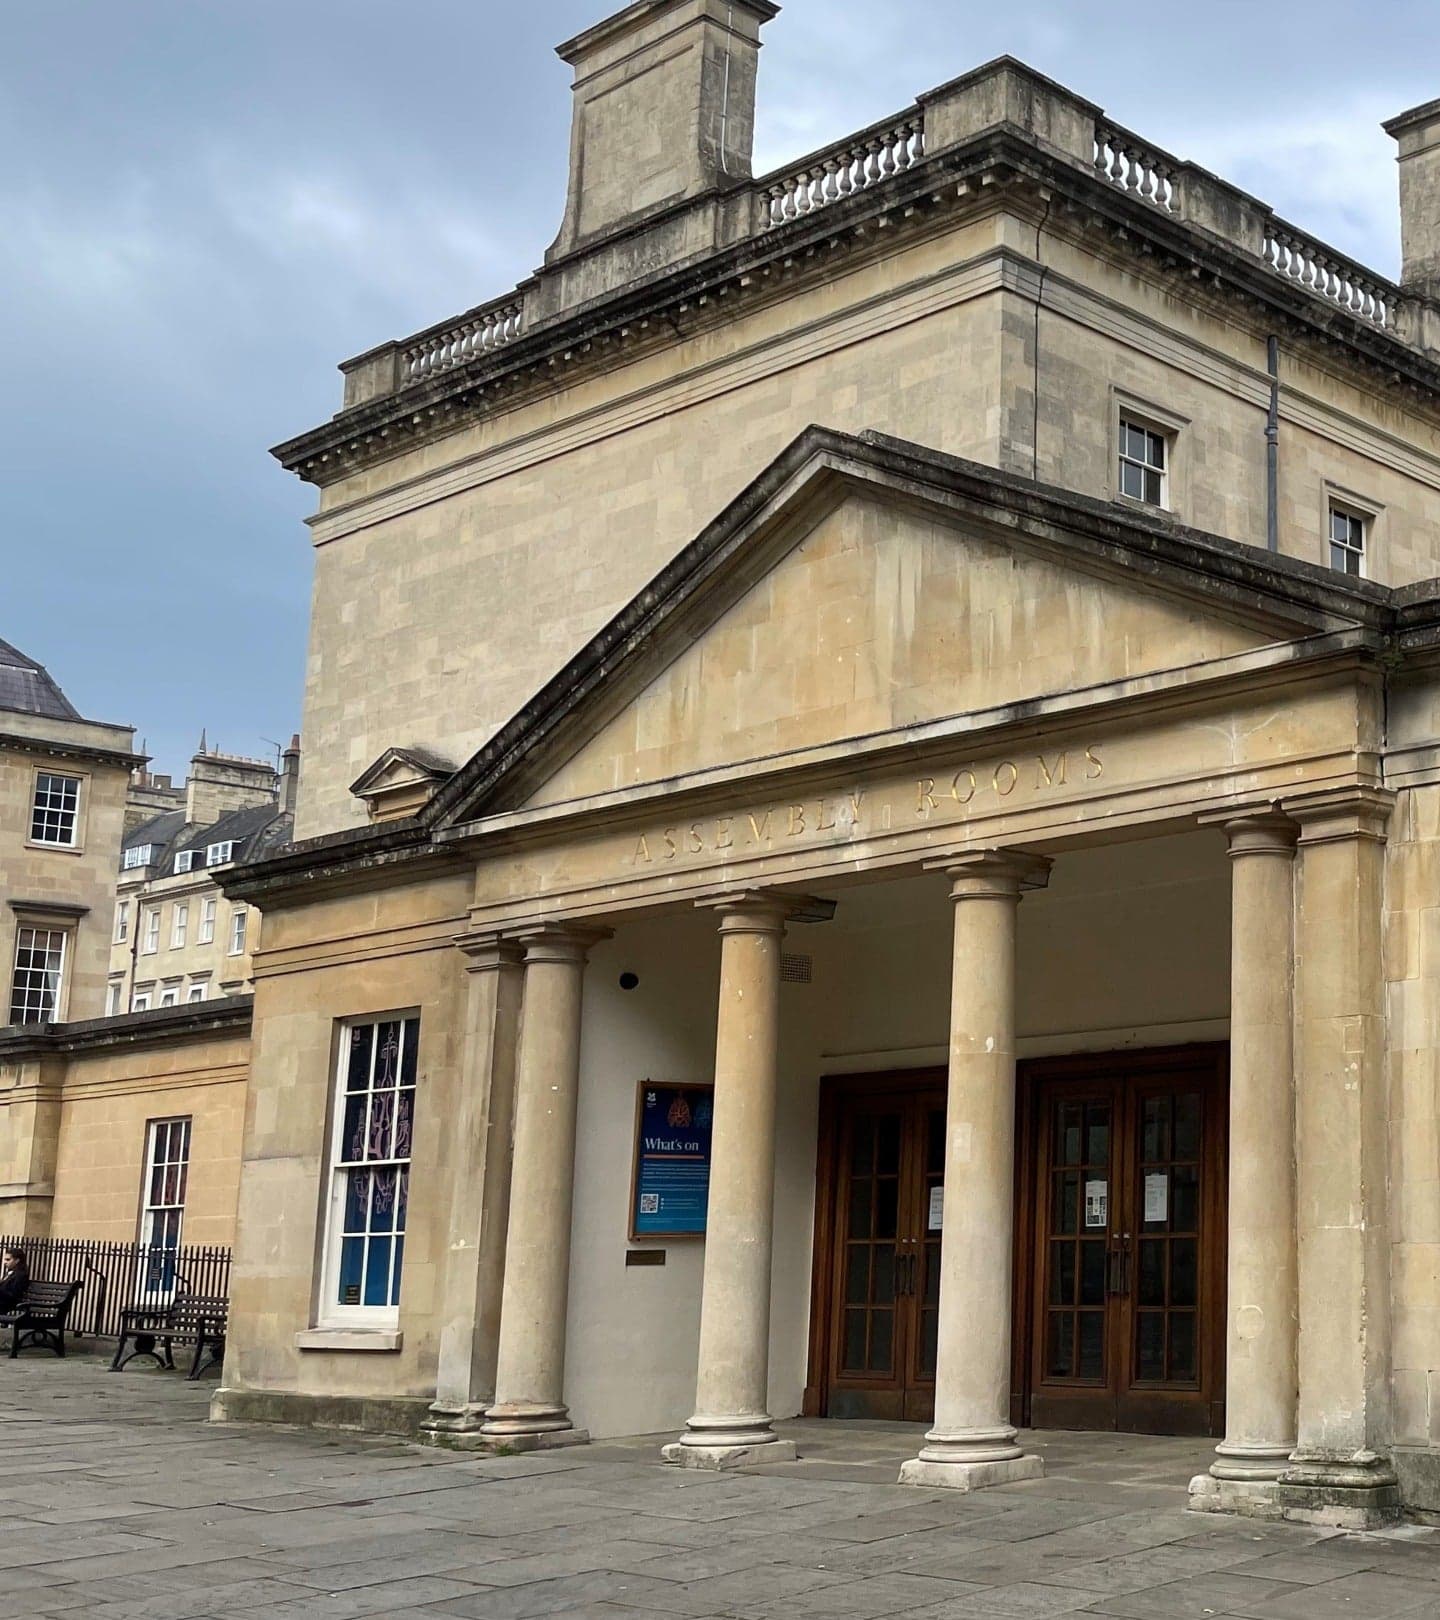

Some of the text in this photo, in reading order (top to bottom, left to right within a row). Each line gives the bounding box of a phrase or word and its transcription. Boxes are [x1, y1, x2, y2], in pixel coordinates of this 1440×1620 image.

[632, 743, 1105, 865] ASSEMBLY ROOMS
[645, 1137, 699, 1151] What's on
